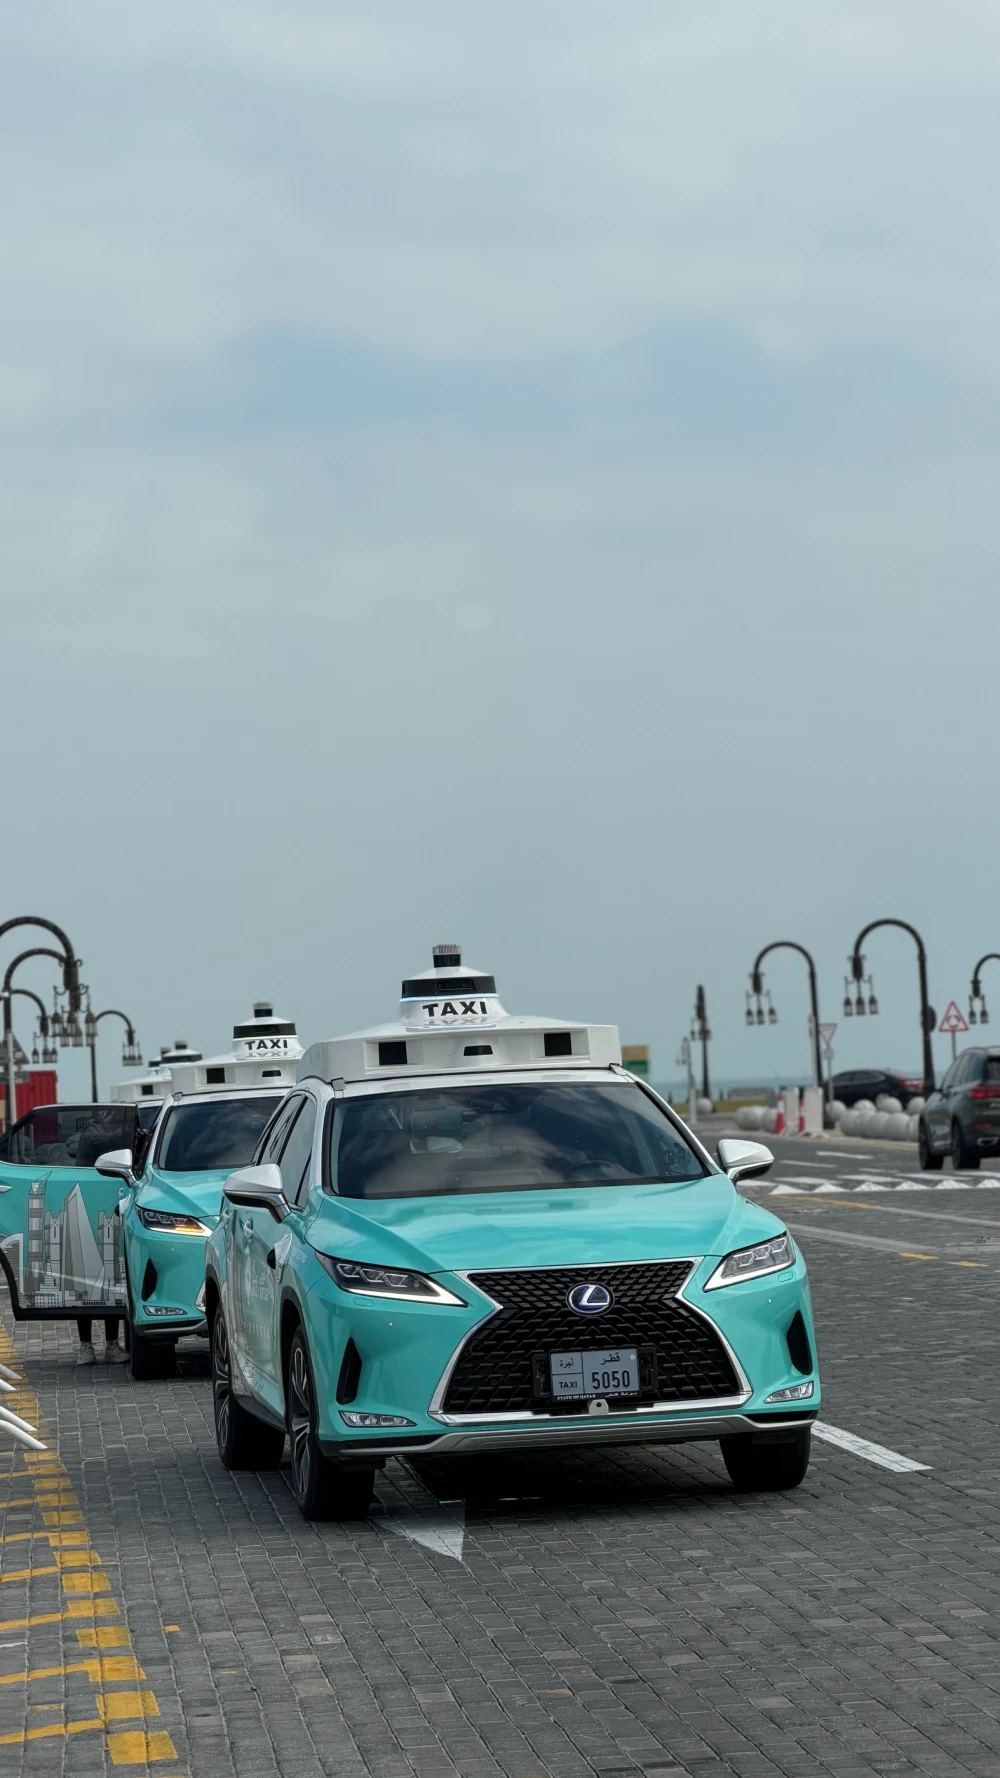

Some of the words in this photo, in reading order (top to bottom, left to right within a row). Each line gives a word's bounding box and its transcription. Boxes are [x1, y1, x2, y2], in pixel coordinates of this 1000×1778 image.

[423, 1001, 488, 1017] TAXI
[245, 1039, 288, 1051] TAXI
[600, 1352, 621, 1365] قطر
[559, 1381, 578, 1389] TAXI
[591, 1370, 631, 1390] 5050
